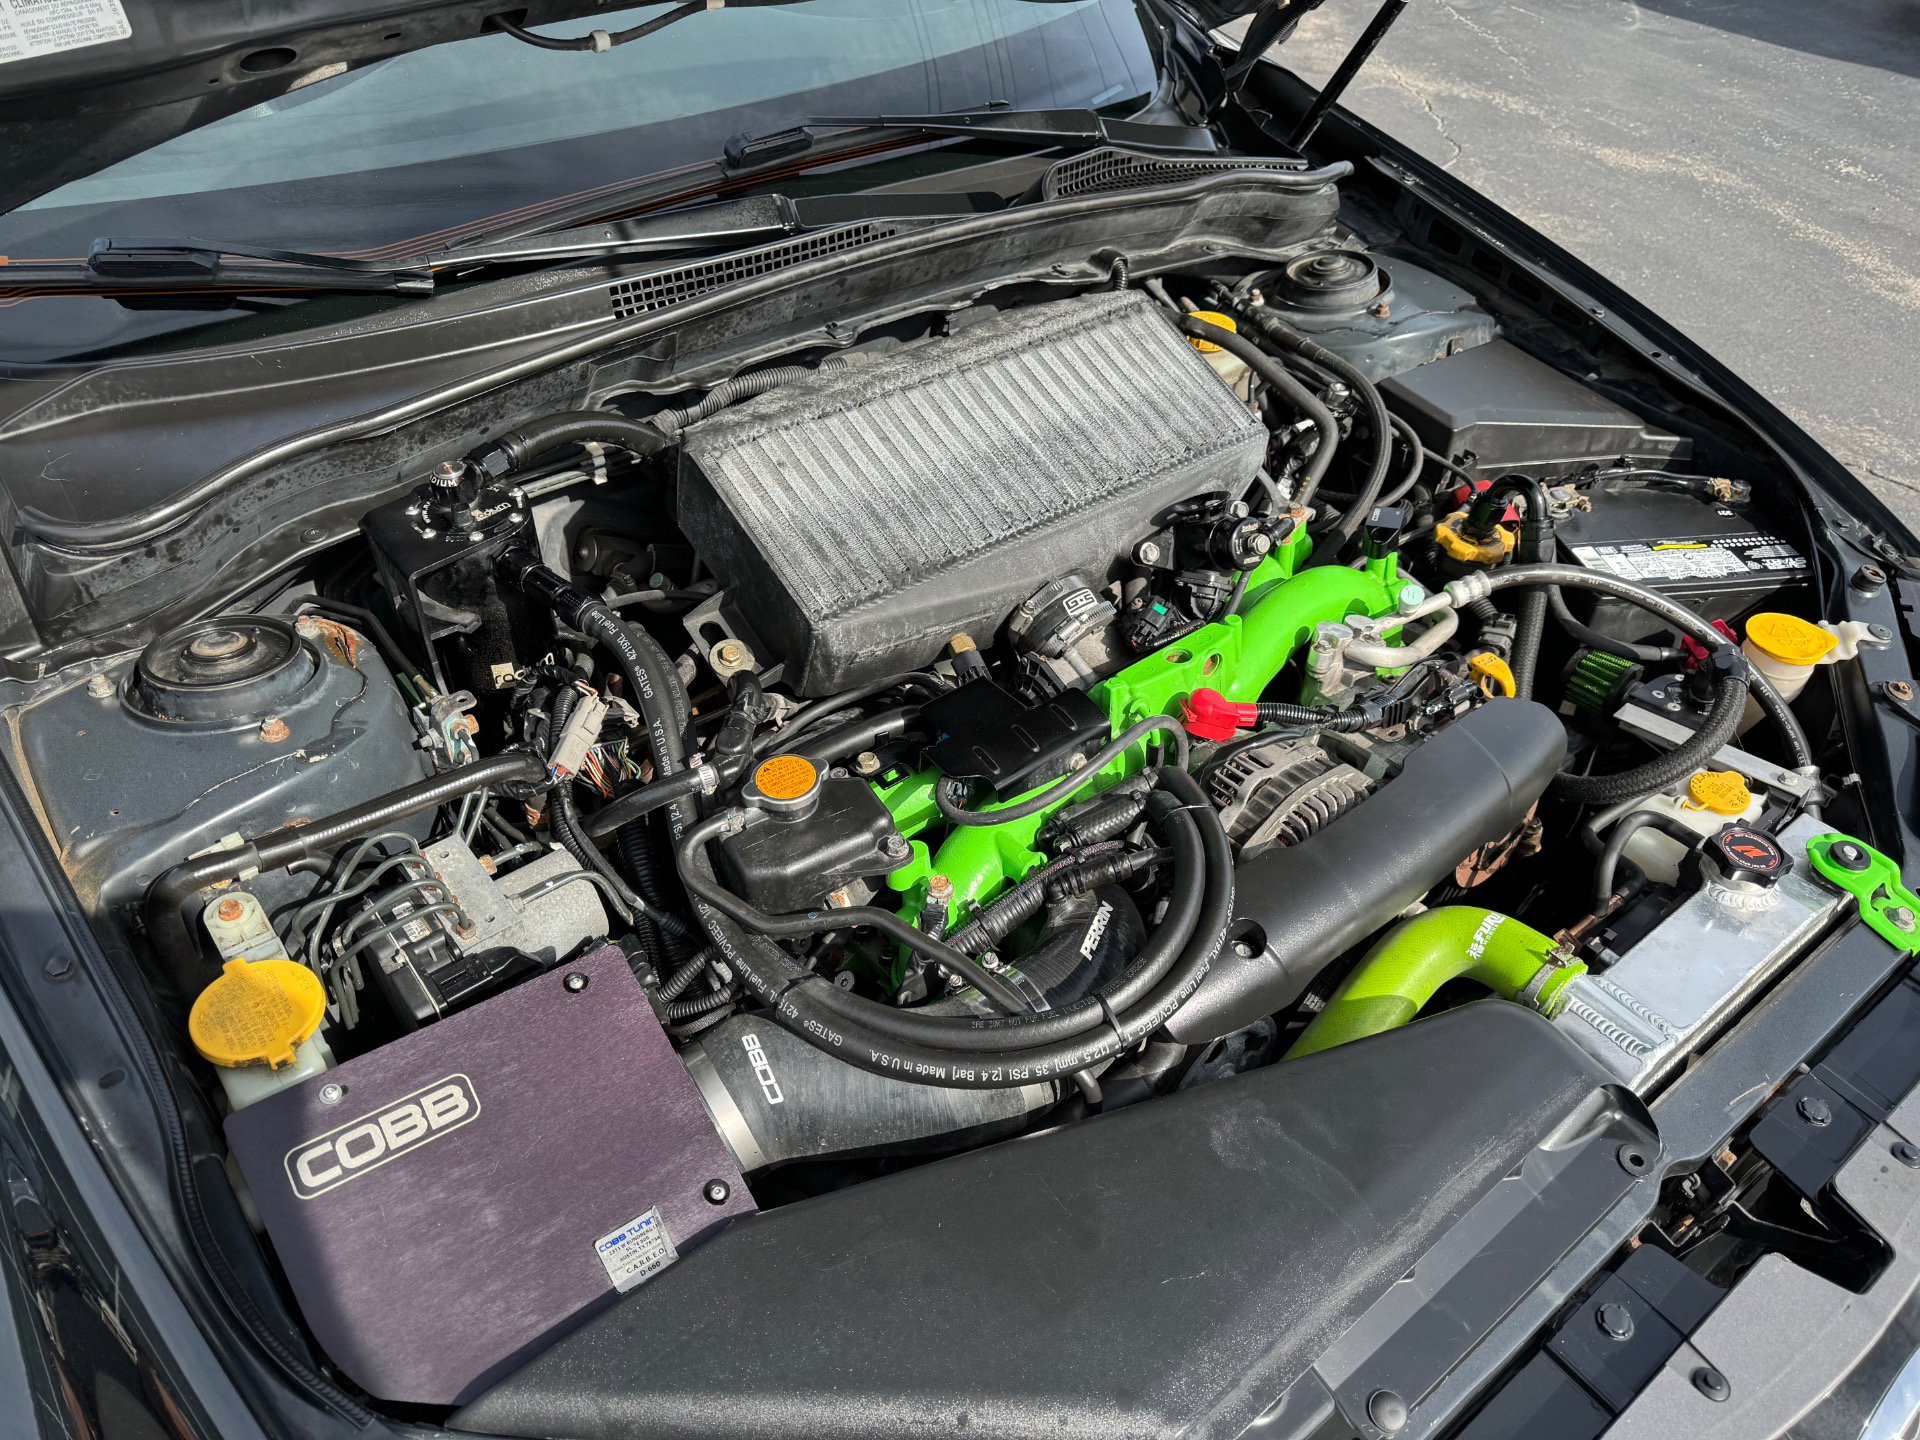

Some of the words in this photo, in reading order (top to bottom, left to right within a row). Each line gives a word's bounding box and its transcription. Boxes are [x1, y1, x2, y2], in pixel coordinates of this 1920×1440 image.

[591, 610, 606, 625] Line
[601, 620, 619, 636] Fuel
[617, 632, 637, 661] 4219XL
[653, 717, 667, 746] U.S.A.
[658, 744, 668, 757] in
[708, 920, 737, 959] PCV/EEC
[1080, 900, 1114, 961] PERRIN
[1209, 928, 1227, 959] 4219XL
[735, 957, 752, 978] Line
[1195, 957, 1210, 984] Fuel
[747, 972, 767, 994] Fuel
[1181, 980, 1198, 999] Line
[1042, 1010, 1060, 1019] FUEL
[1063, 996, 1097, 1014] INJECTIO
[1138, 997, 1179, 1037] PCV/EEC
[803, 1018, 843, 1047] GATES®
[741, 1034, 784, 1105] COBB
[869, 1049, 901, 1071] U.S.A.
[903, 1060, 913, 1070] in
[1035, 1064, 1050, 1077] 35
[1056, 1057, 1079, 1073] mm]
[916, 1063, 946, 1079] Made
[952, 1065, 975, 1081] Bar]
[981, 1066, 1003, 1082] [2.4
[1009, 1067, 1029, 1081] PSI
[296, 1084, 469, 1188] COBB
[598, 1233, 627, 1253] COBB
[640, 1260, 661, 1277] D-660
